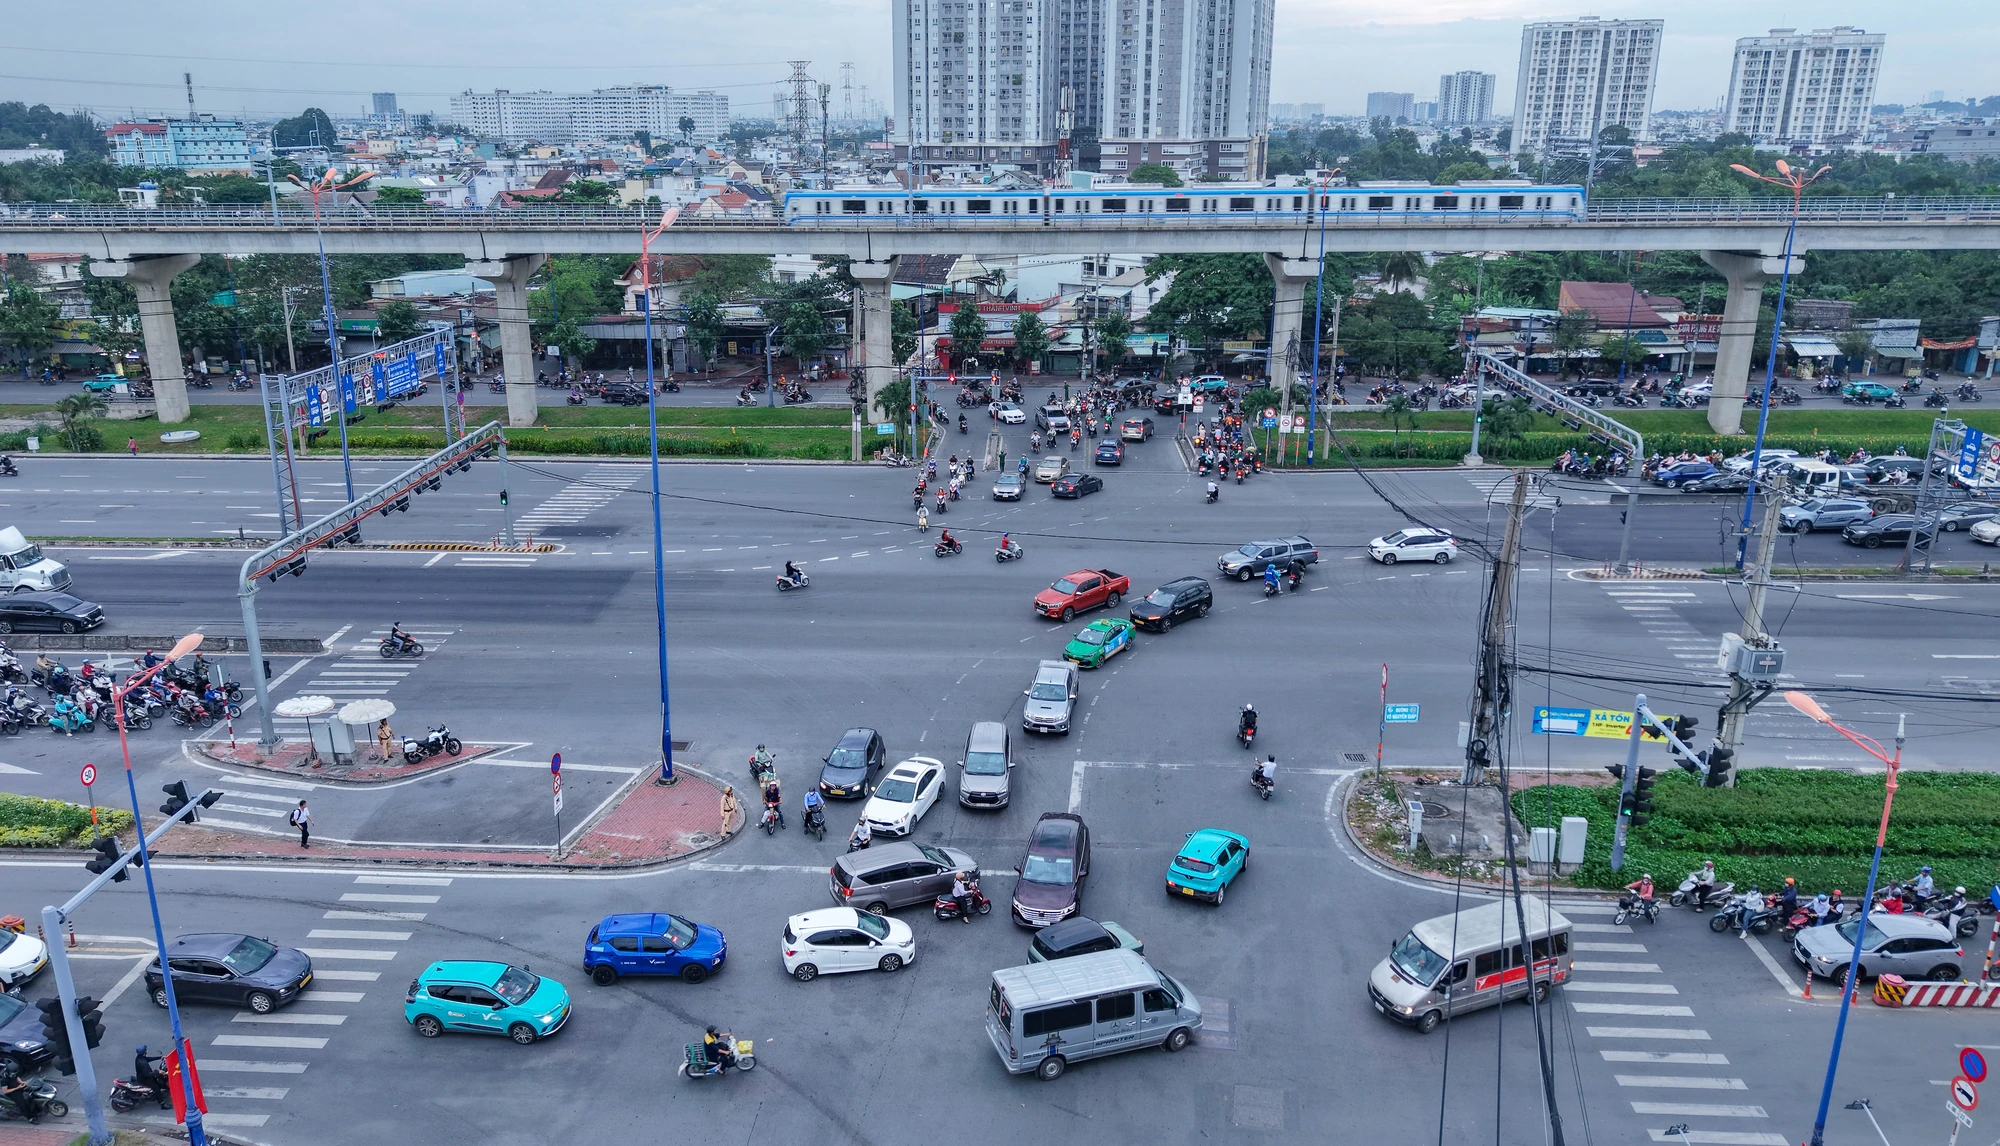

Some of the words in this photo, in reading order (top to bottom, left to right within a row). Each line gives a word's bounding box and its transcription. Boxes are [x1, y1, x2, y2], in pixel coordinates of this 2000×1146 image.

[1594, 712, 1607, 721] XẢ
[85, 769, 93, 781] 50
[1095, 1035, 1135, 1046] SPRINTER
